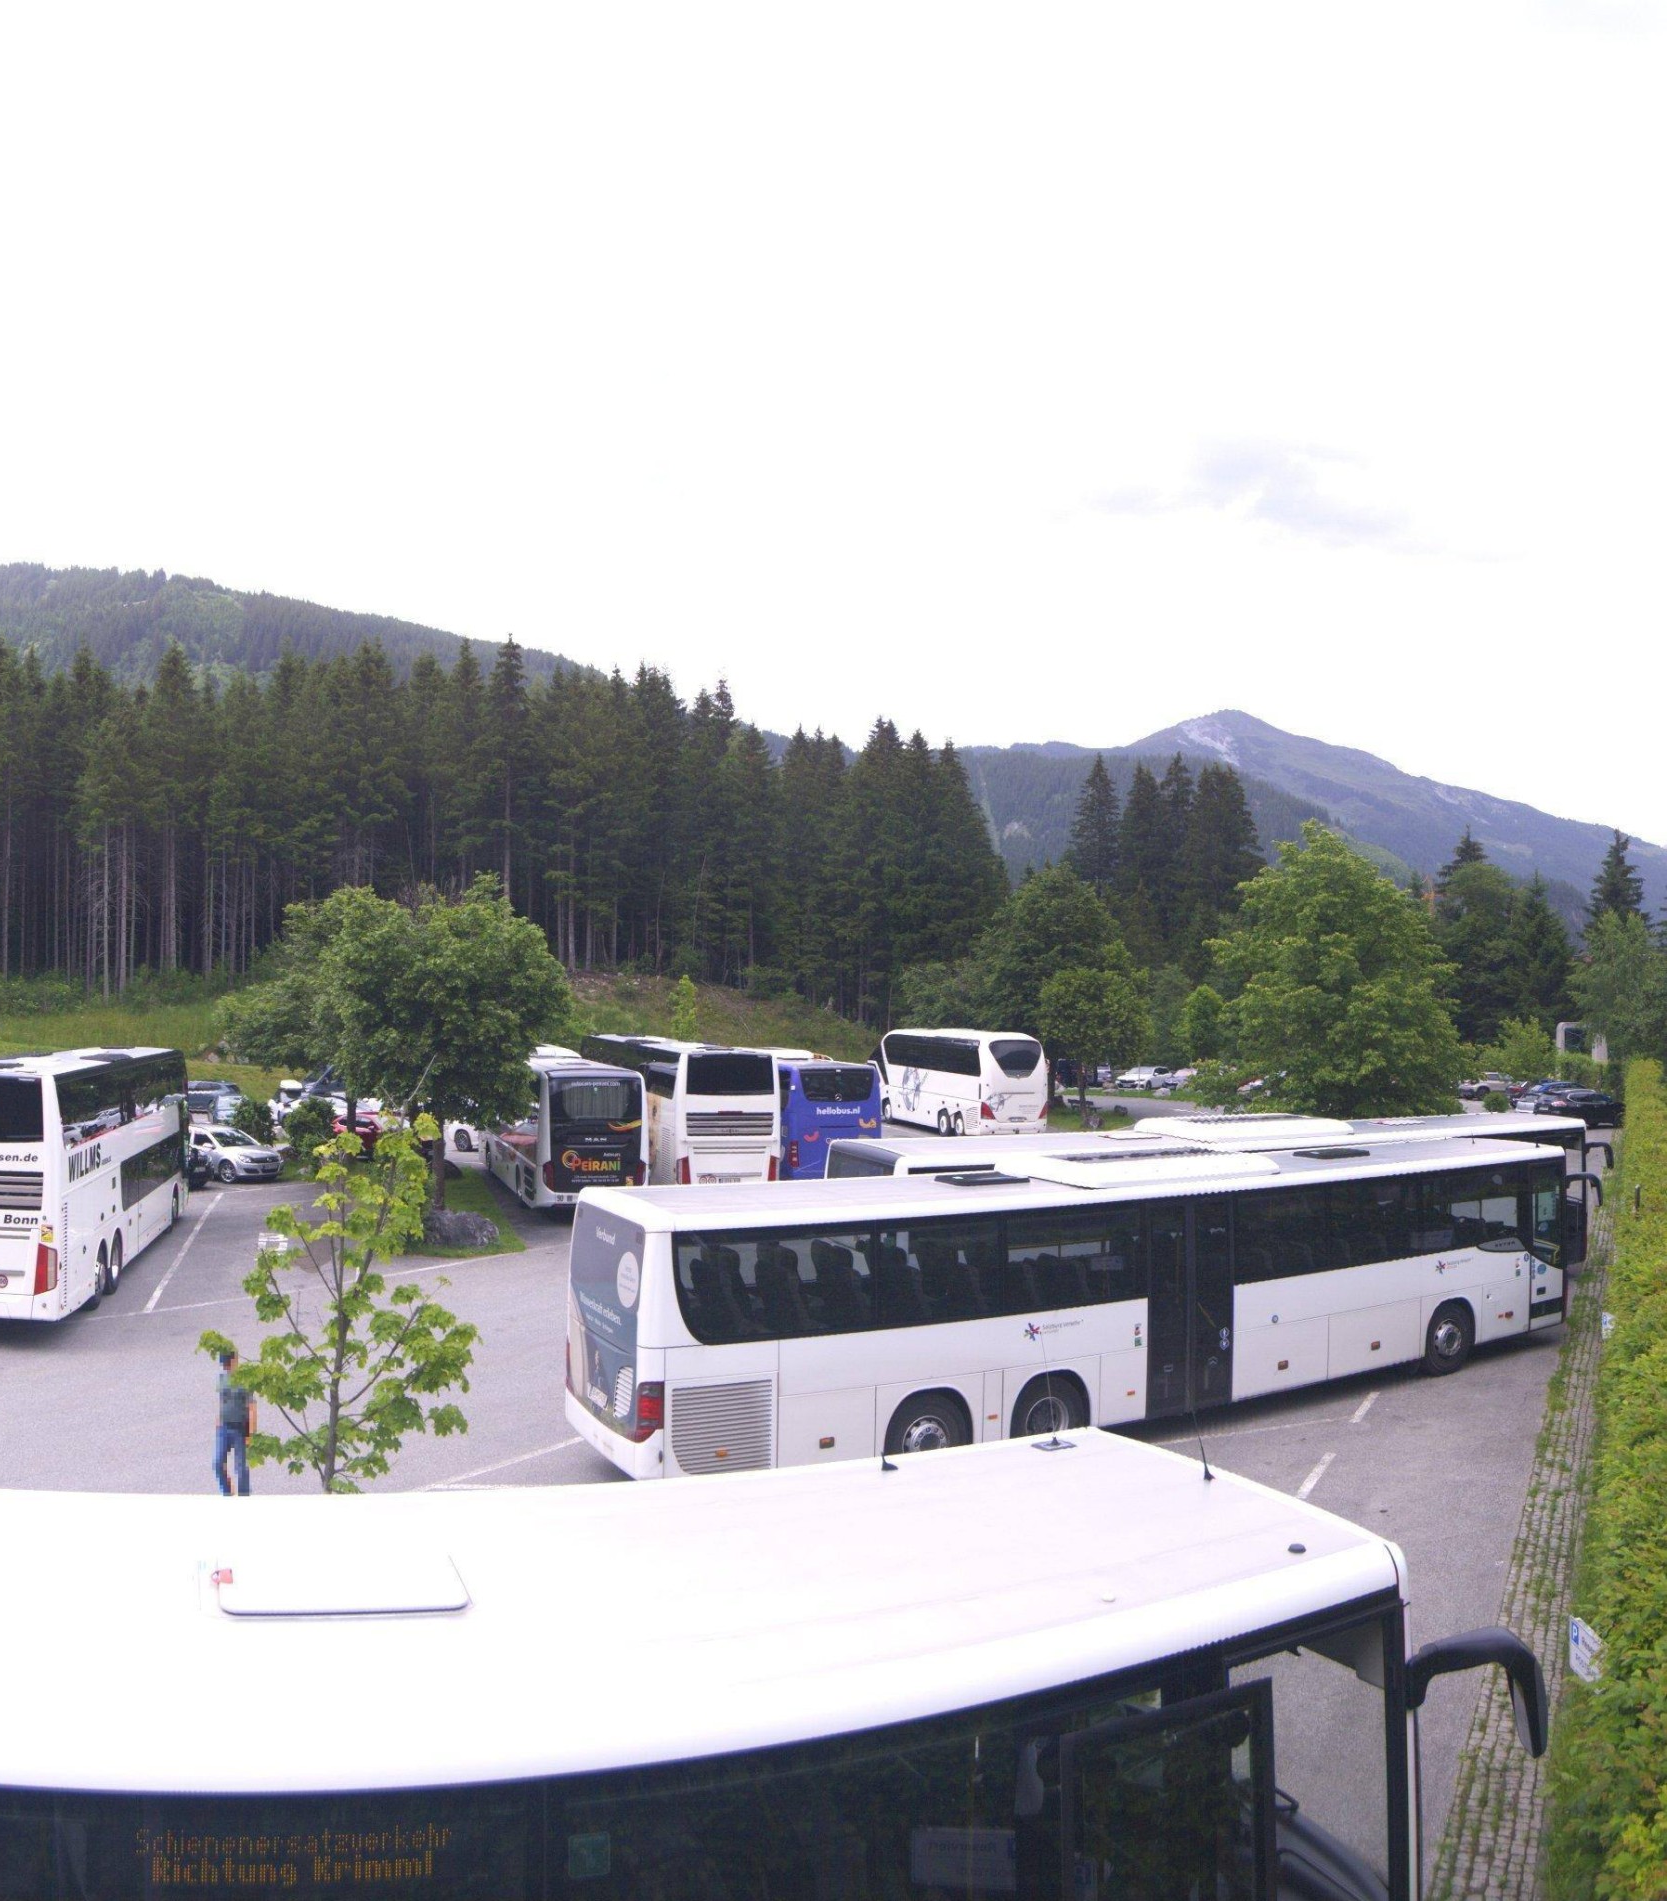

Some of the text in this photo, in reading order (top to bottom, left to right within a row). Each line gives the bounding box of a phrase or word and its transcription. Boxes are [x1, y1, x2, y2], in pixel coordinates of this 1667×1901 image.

[816, 1106, 861, 1115] hellobus.nl
[68, 1142, 102, 1183] WILLMS
[3, 1213, 39, 1225] Bonn
[135, 1822, 453, 1856] Schienenersatzverkehr
[151, 1851, 434, 1887] Richtung Krimml
